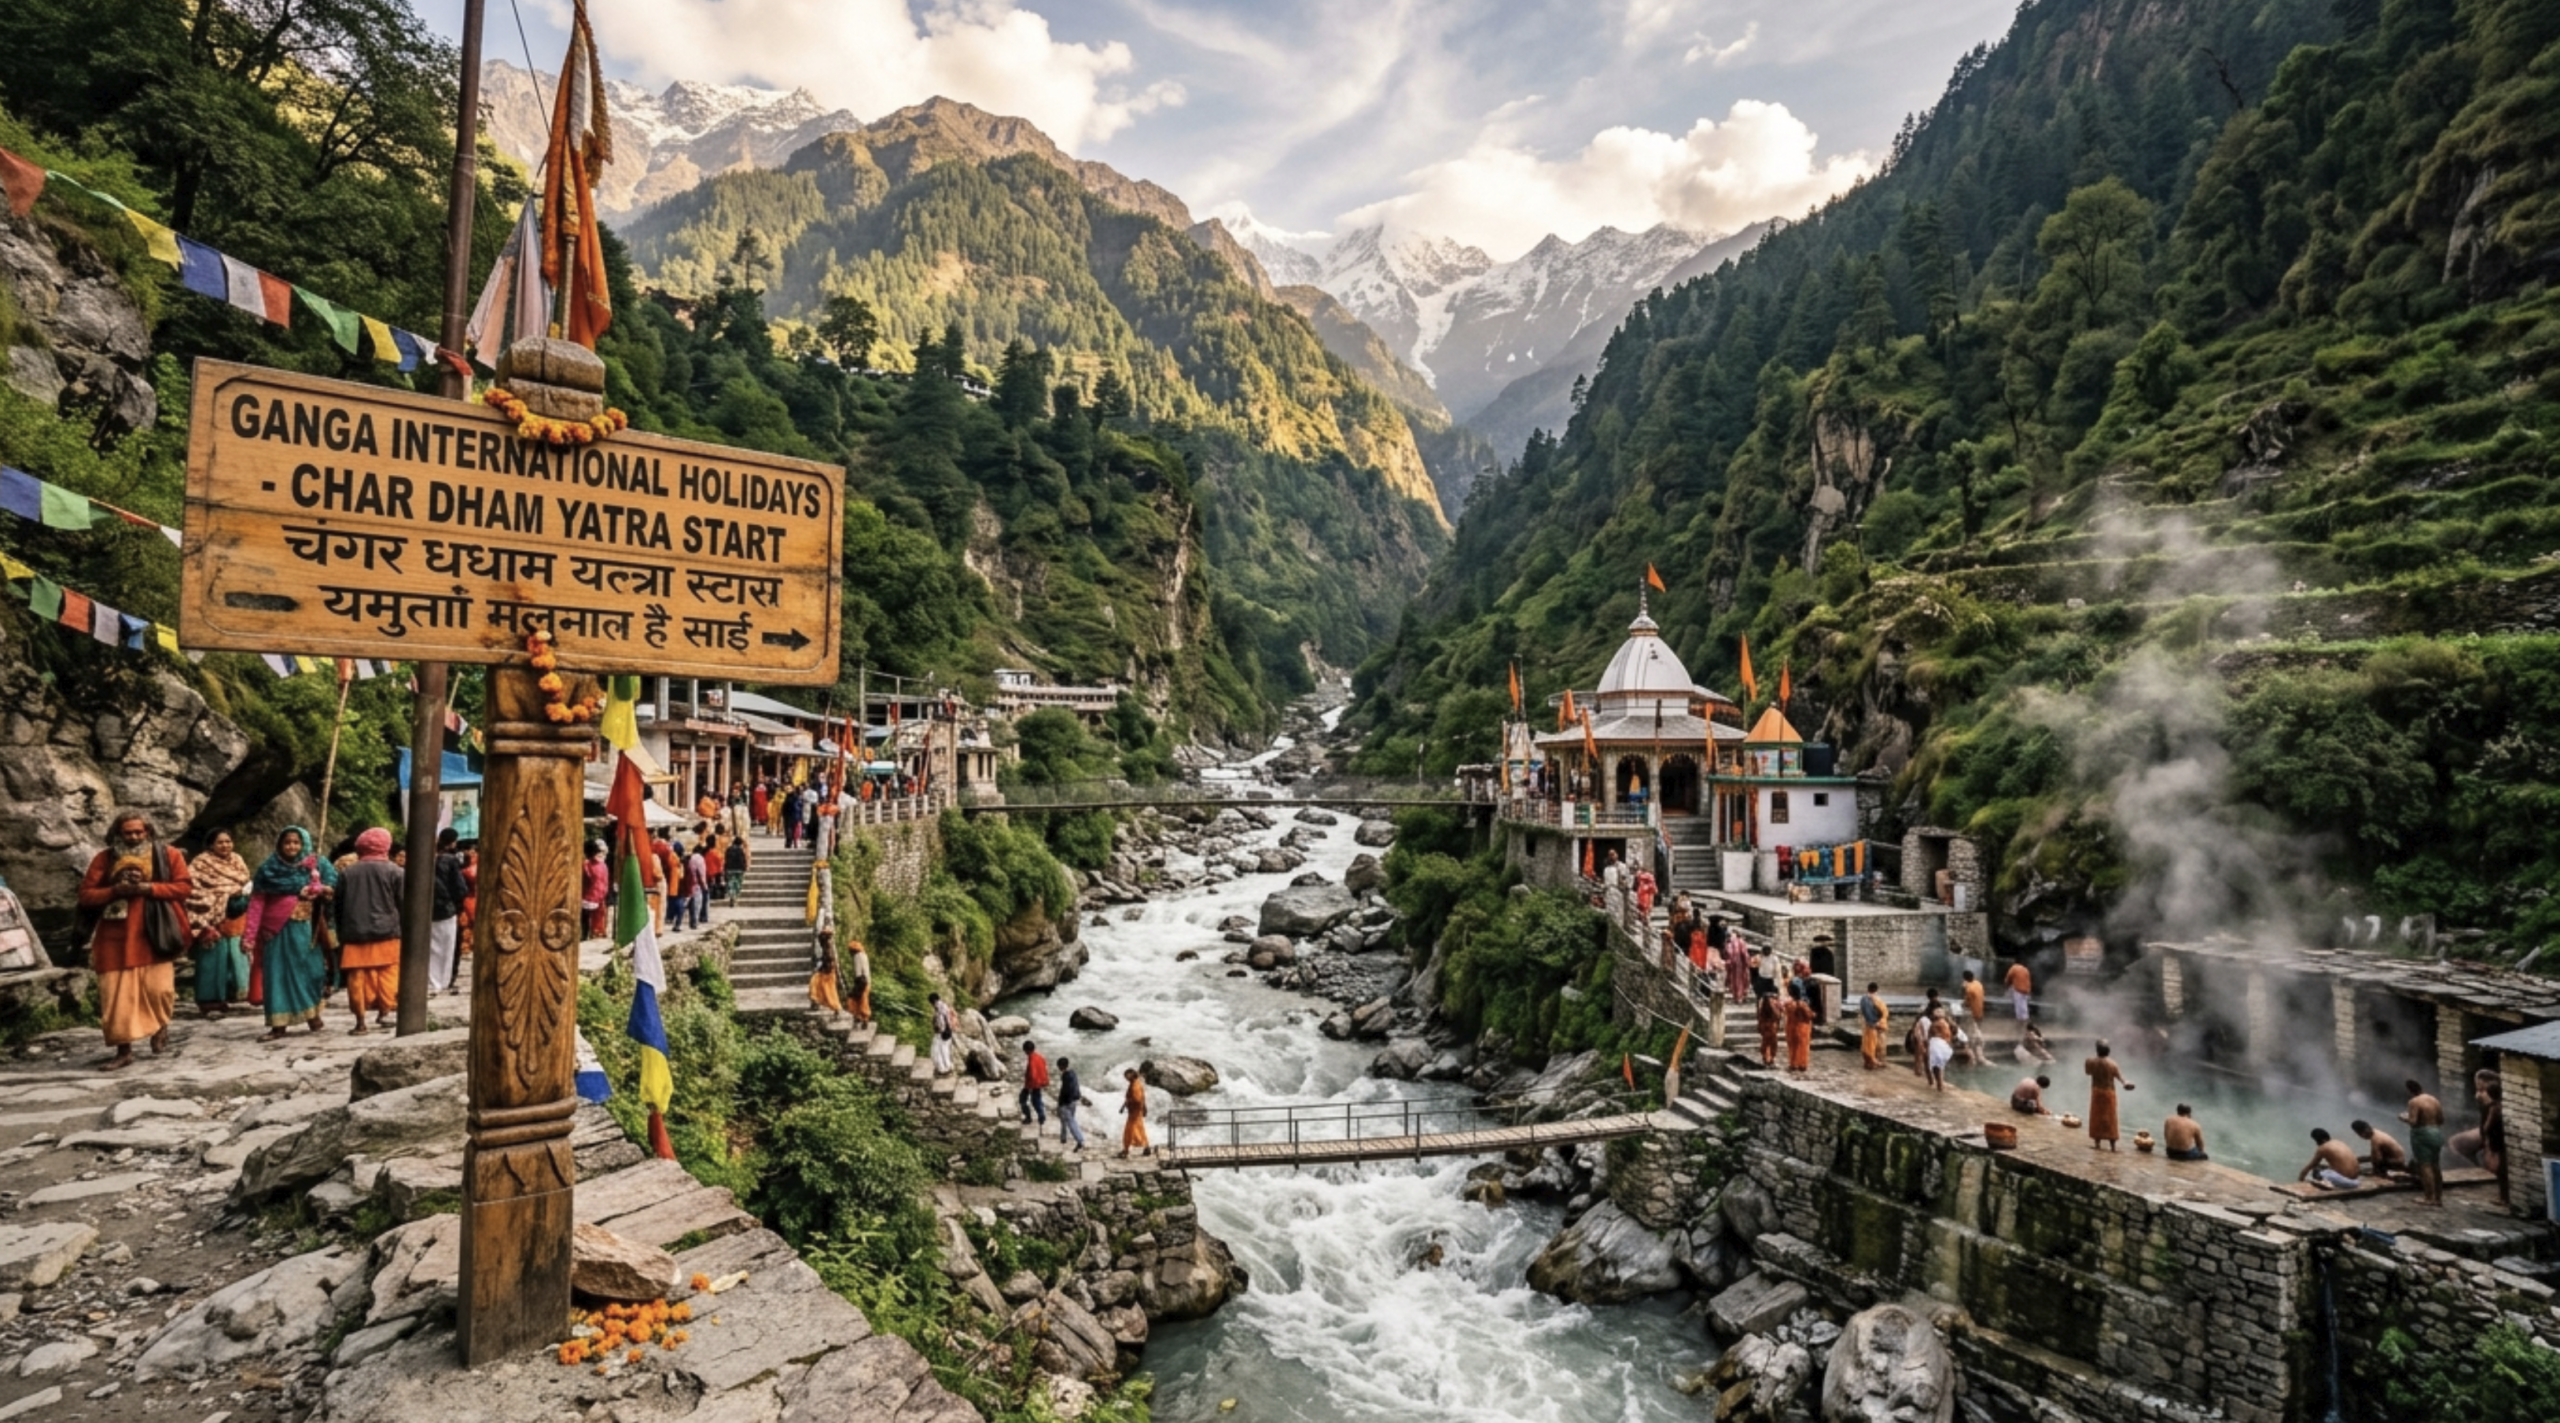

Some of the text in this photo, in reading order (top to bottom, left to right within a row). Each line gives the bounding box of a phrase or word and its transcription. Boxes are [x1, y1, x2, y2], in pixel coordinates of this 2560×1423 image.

[231, 394, 820, 519] GANGA INTERNATIONAL HOLIDAYS
[291, 463, 413, 519] CHAR
[429, 481, 543, 535] DHAM
[557, 498, 672, 550] YATRA
[683, 516, 786, 563] START
[643, 604, 672, 648] है
[683, 611, 753, 651] साई
